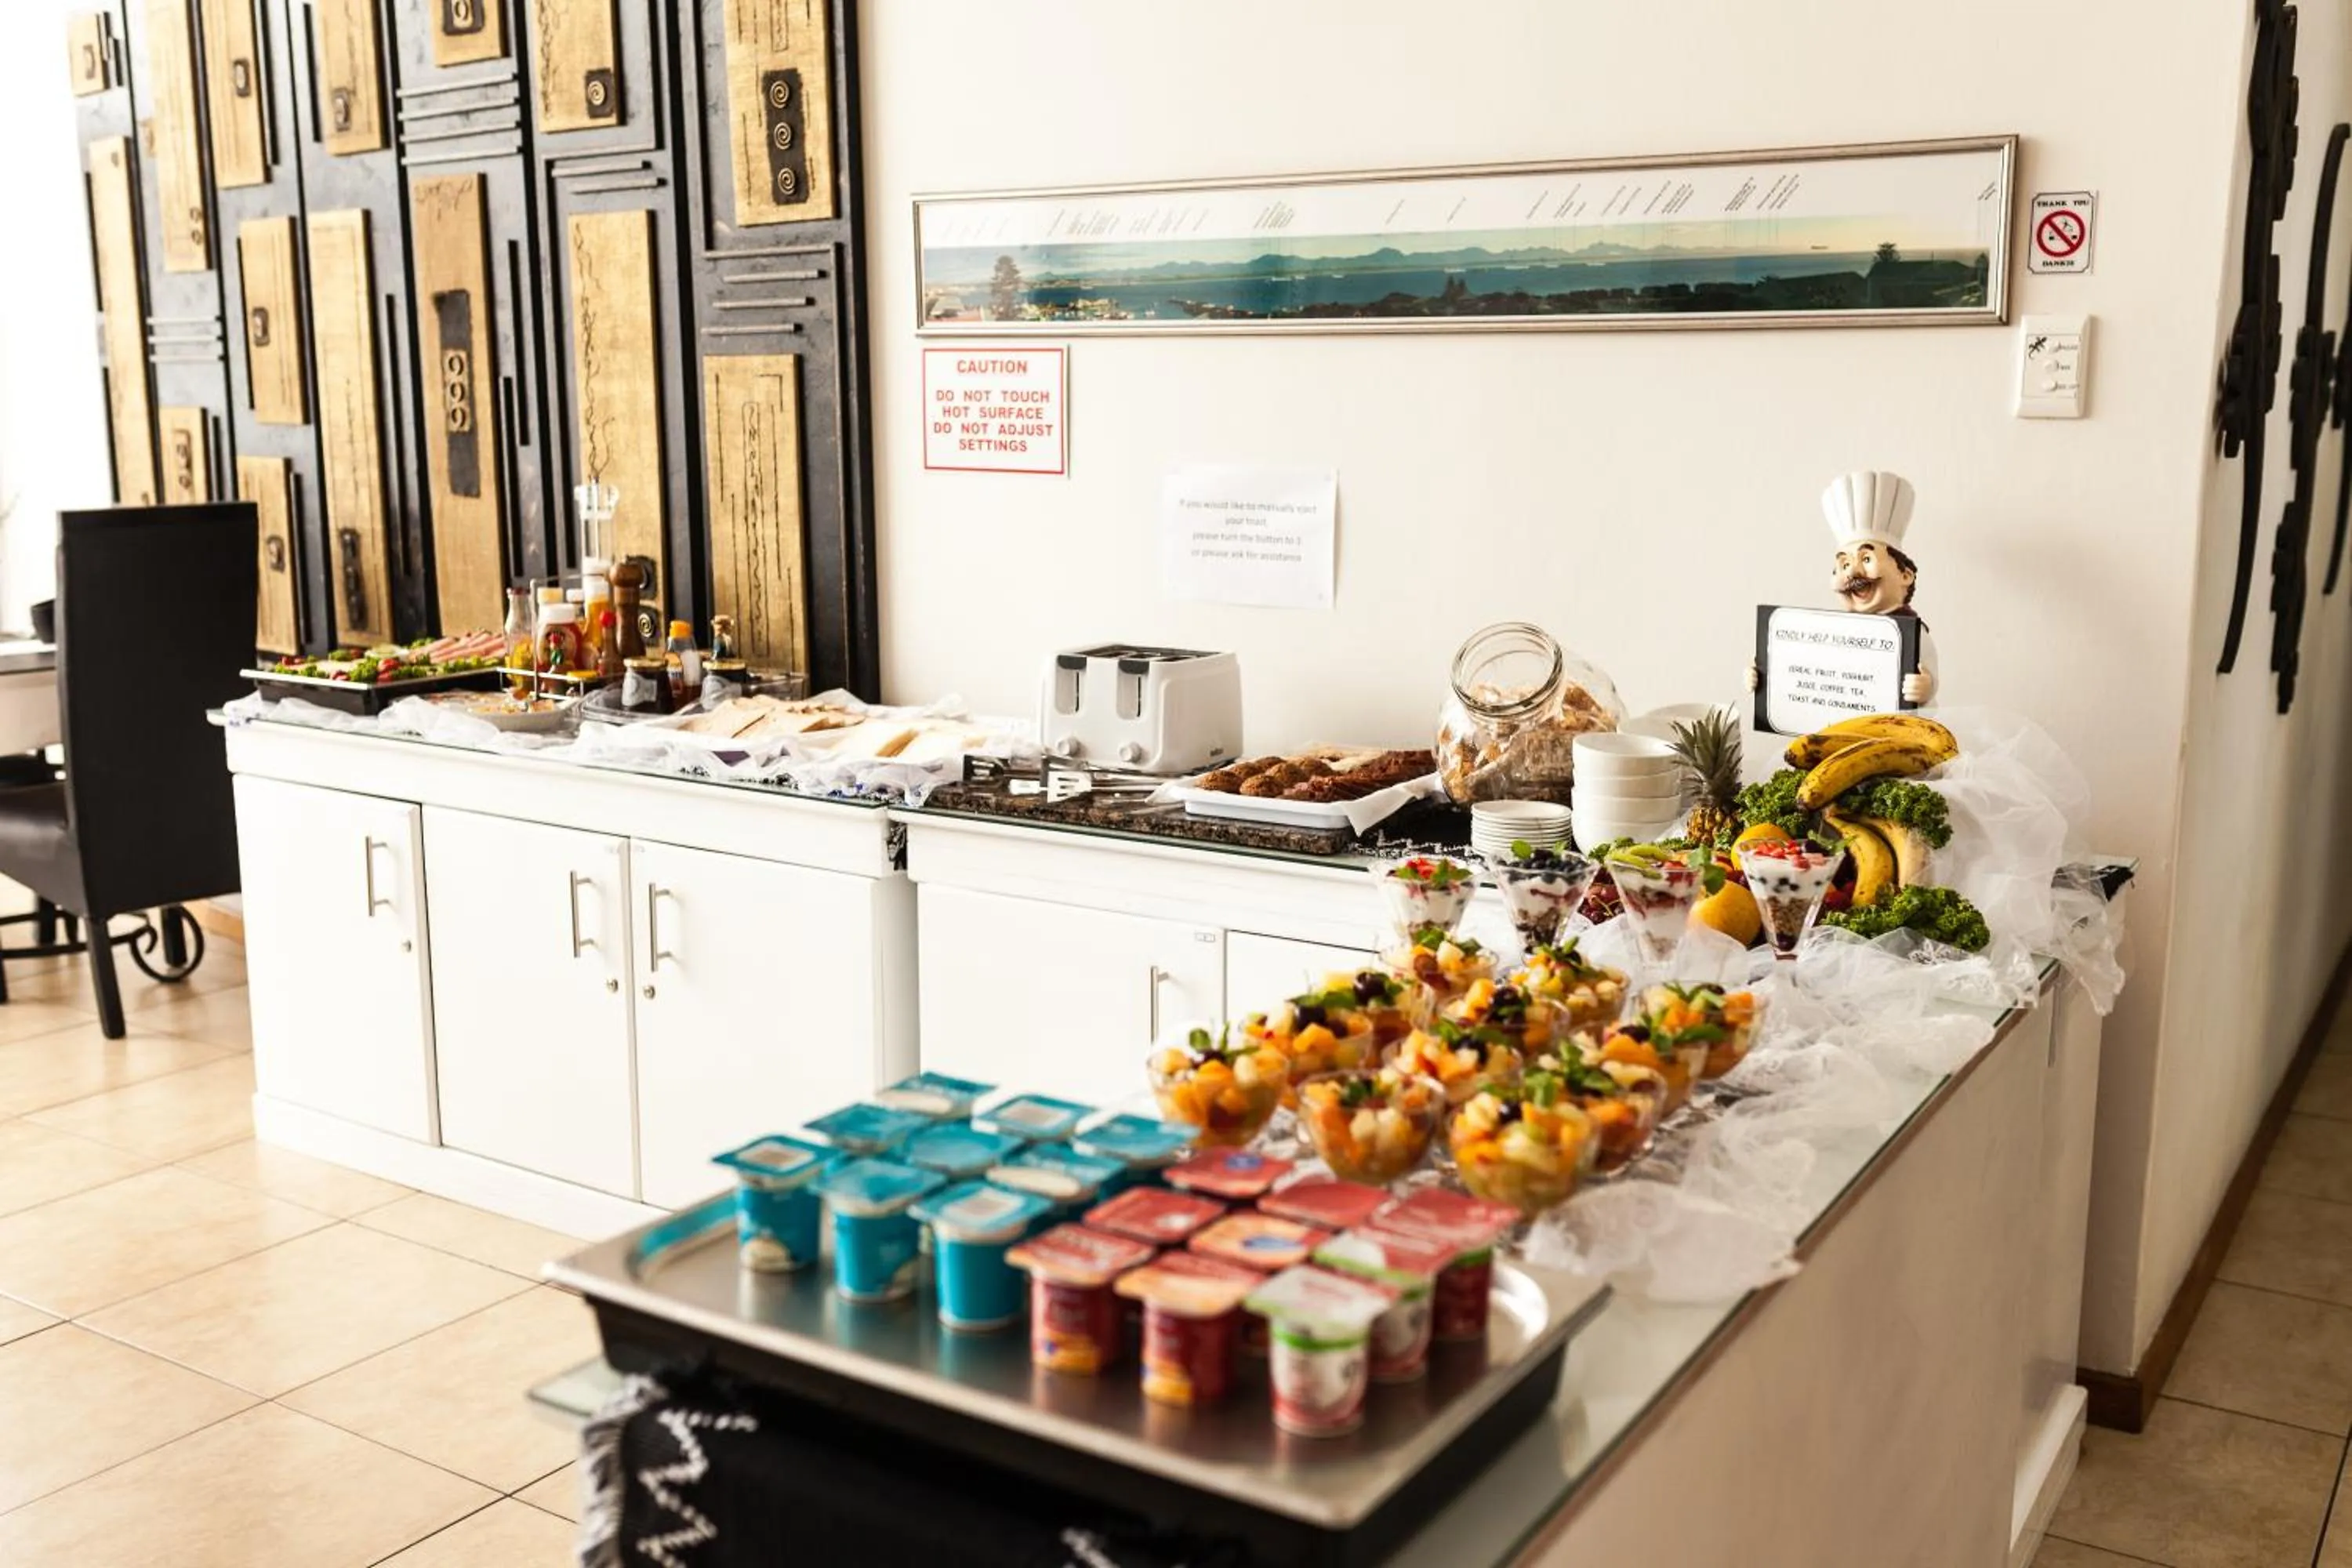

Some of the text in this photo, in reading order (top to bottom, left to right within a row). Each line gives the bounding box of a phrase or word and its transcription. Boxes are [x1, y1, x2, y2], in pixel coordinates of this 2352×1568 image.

[956, 359, 1028, 374] CAUTION
[935, 390, 1050, 403] DO NOT TOUCH
[942, 405, 1044, 419] HOT SURFACE
[933, 422, 1054, 436] DO NOT ADJUST
[958, 438, 1028, 452] SETTINGS
[1775, 629, 1806, 641] KINDLY
[1807, 632, 1829, 643] HELP
[1831, 633, 1877, 648] YOURSELF
[1787, 692, 1809, 704] TOAST
[1811, 696, 1827, 706] AND
